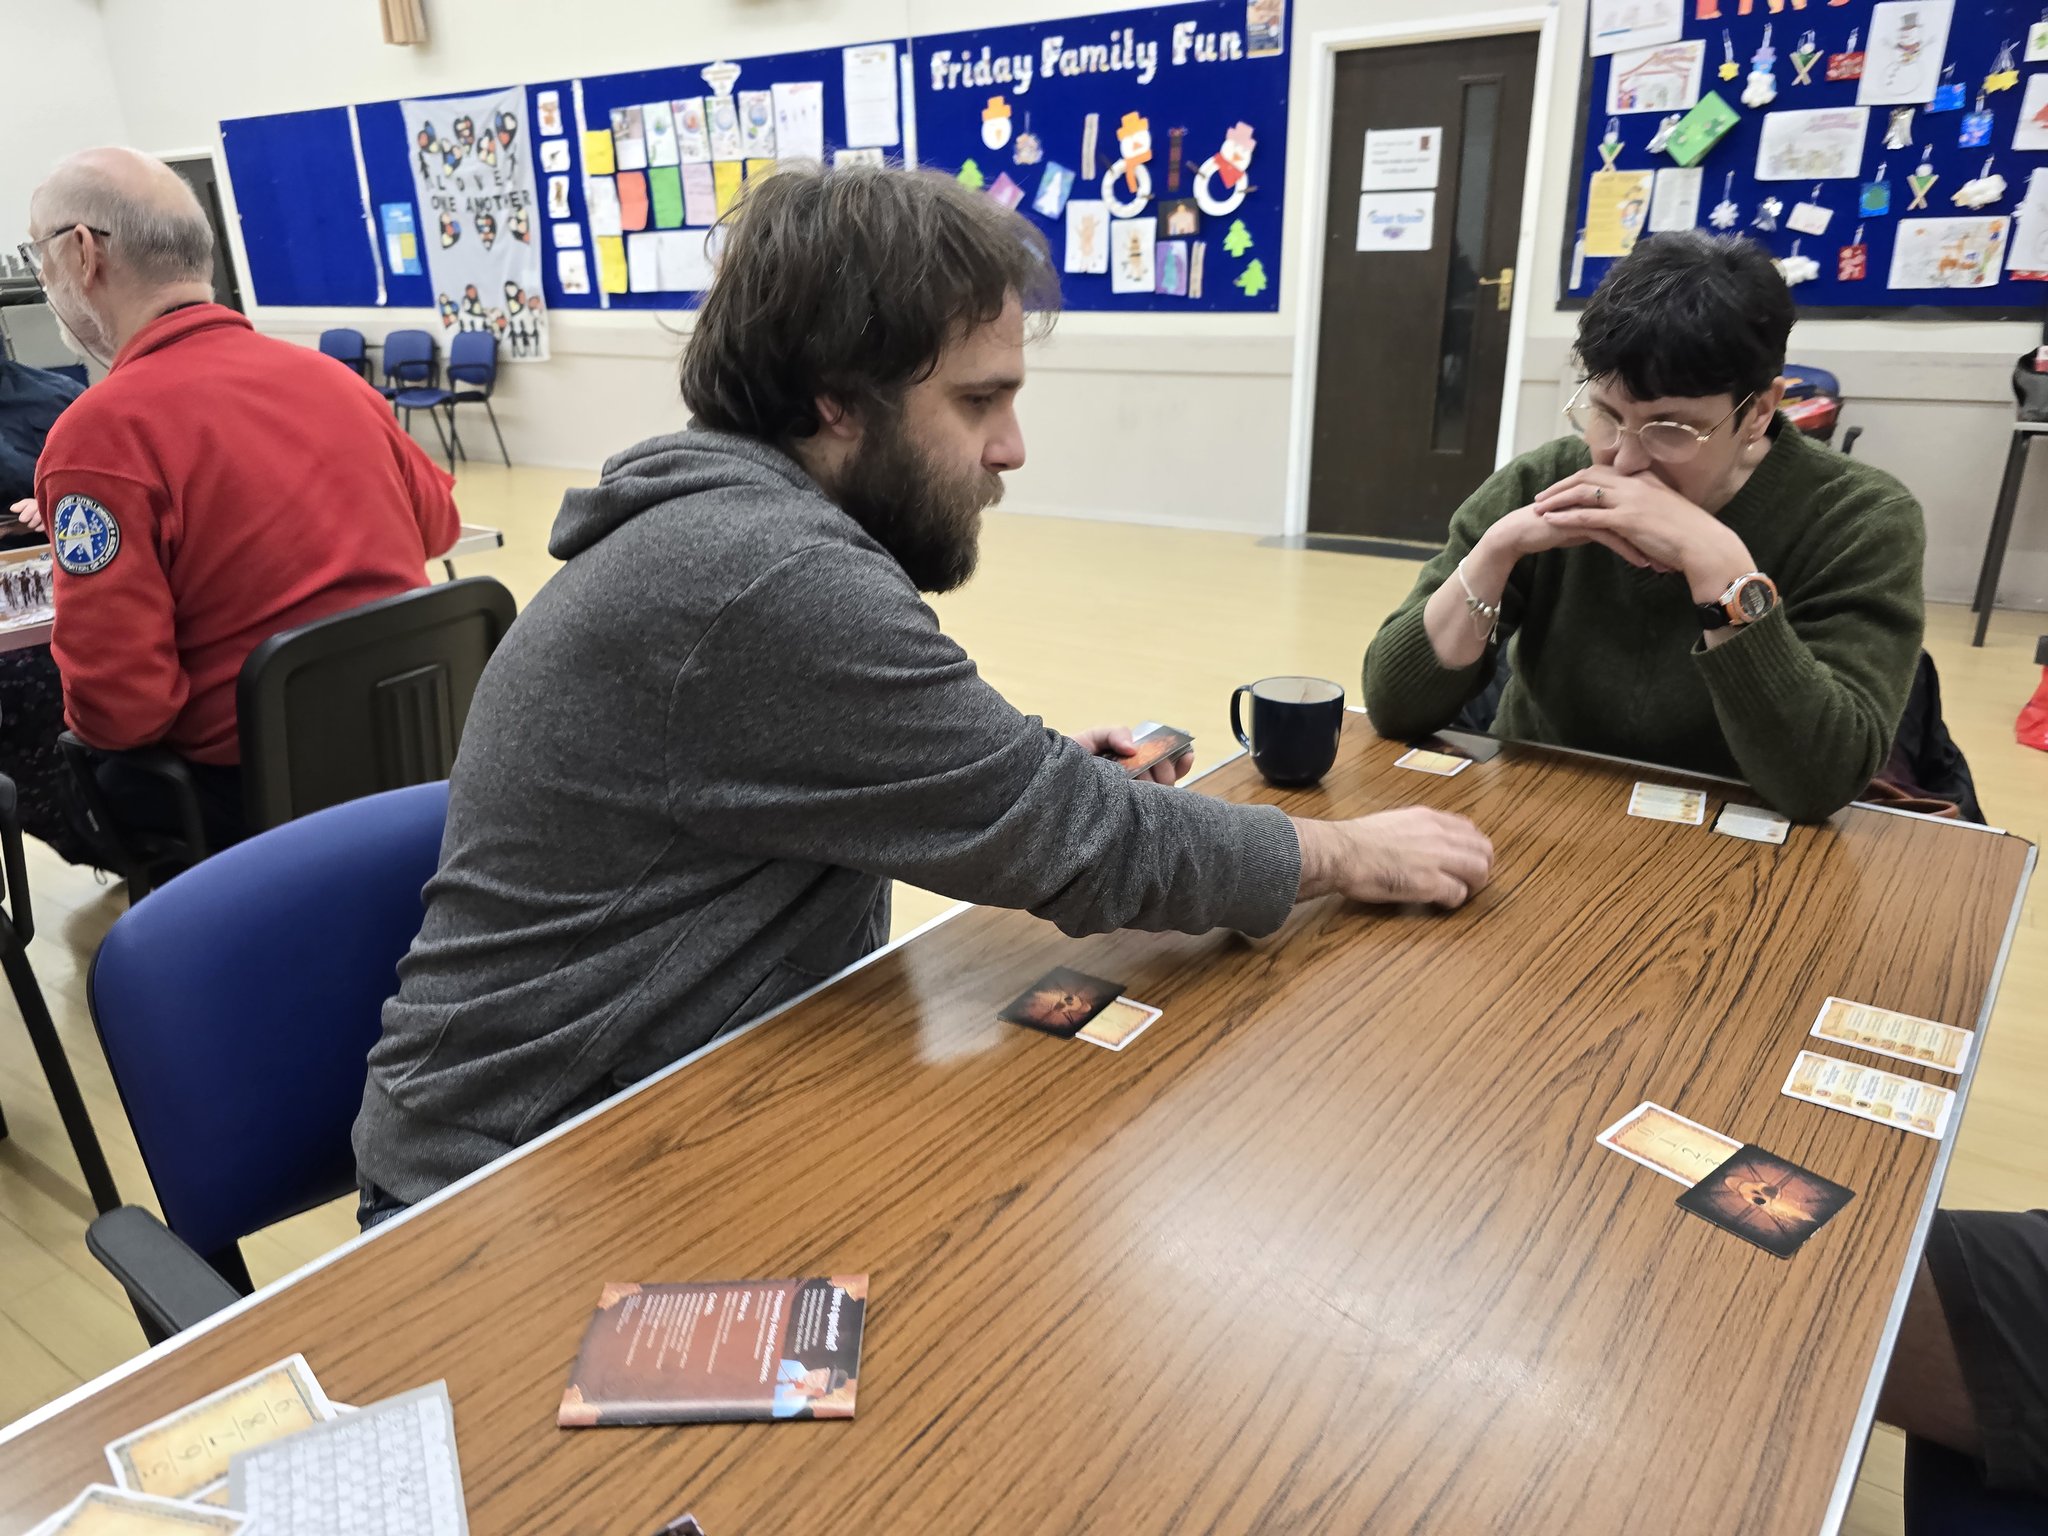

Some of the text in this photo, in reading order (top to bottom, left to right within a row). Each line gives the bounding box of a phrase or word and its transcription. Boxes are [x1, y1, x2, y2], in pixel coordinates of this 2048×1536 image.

[930, 46, 1033, 95] Friday
[1040, 27, 1158, 85] Family
[1171, 20, 1243, 66] Fun
[437, 170, 502, 191] LOVE
[431, 189, 531, 212] ONE ANOTHER
[1682, 1147, 1701, 1160] 2
